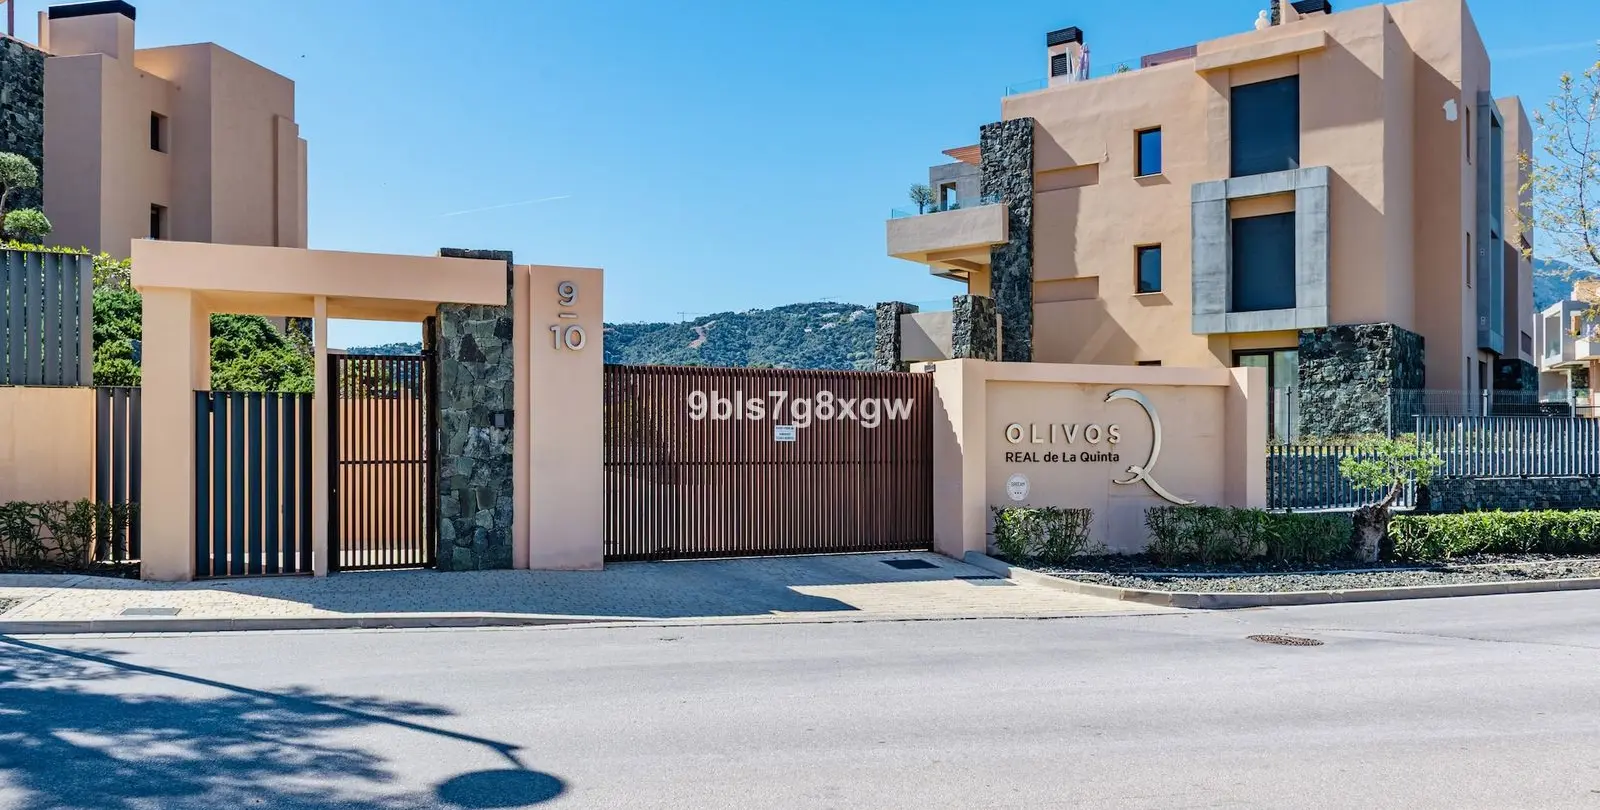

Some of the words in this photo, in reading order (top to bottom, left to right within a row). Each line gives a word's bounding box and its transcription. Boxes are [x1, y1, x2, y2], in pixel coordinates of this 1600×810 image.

[557, 281, 577, 307] 9
[549, 323, 586, 351] 10
[1005, 423, 1121, 444] OLIVOS
[1005, 452, 1040, 462] REAL
[1043, 452, 1059, 462] de
[1062, 452, 1077, 462] La
[1080, 451, 1120, 462] Quinta
